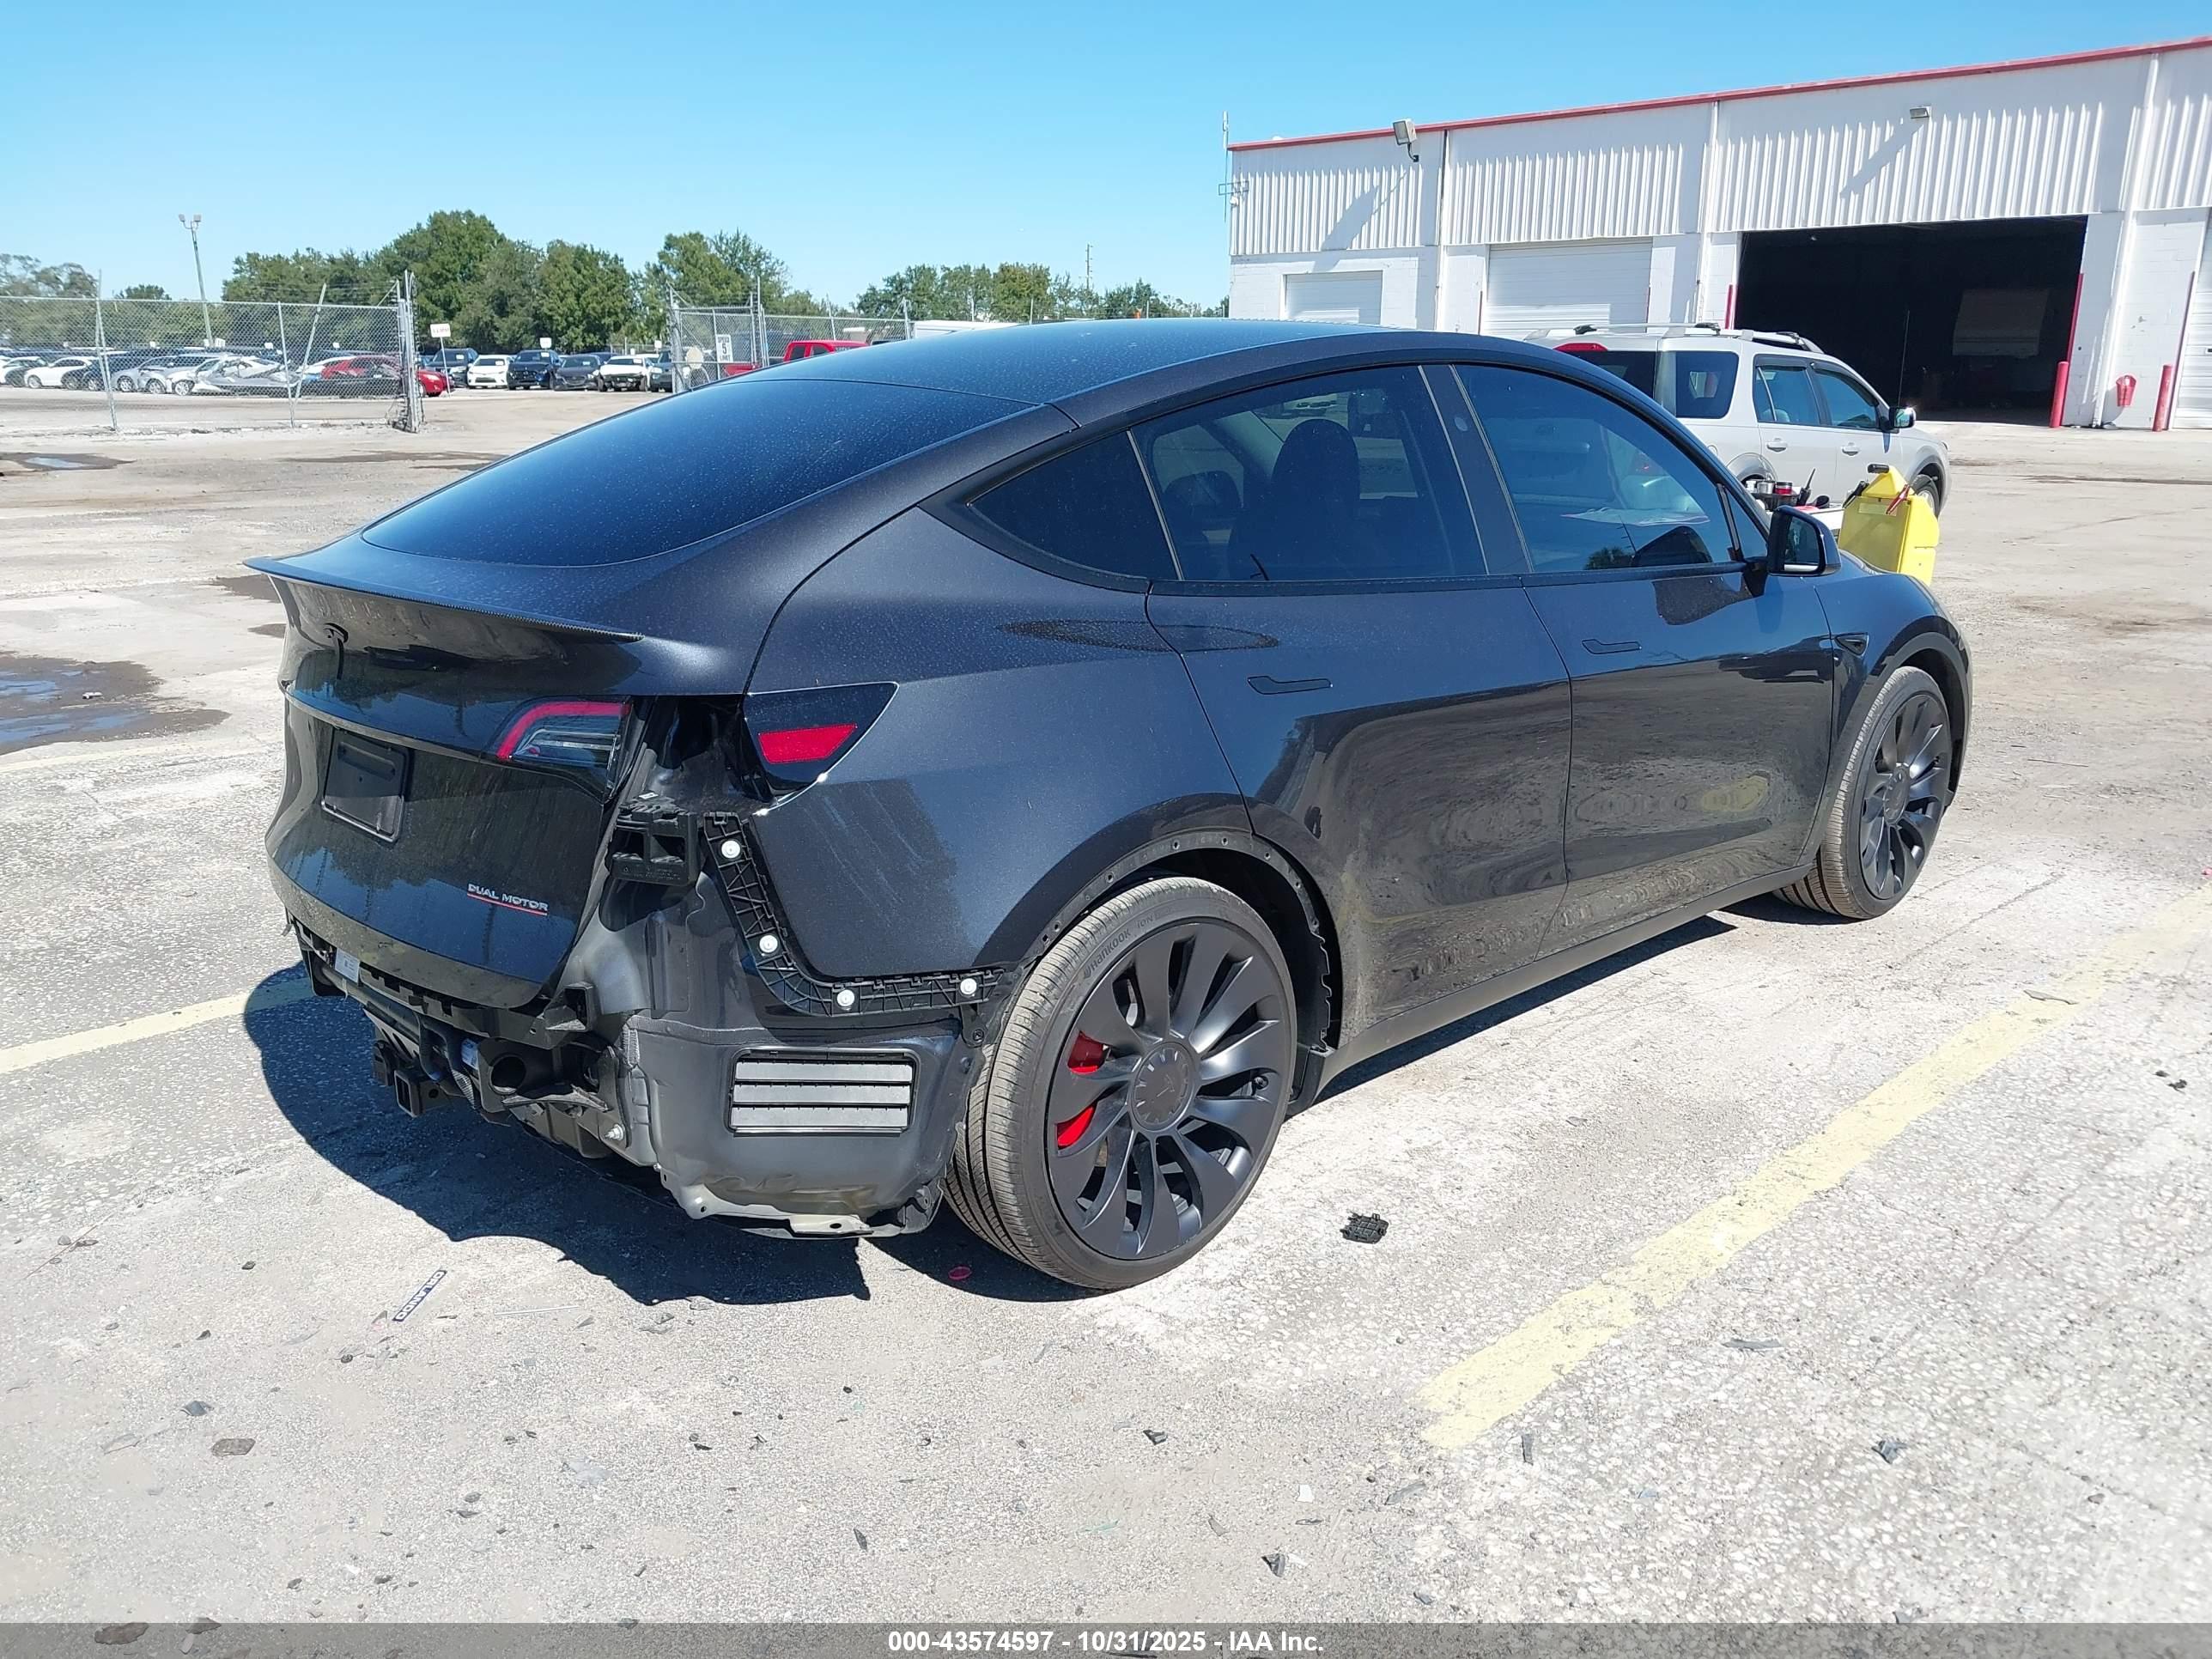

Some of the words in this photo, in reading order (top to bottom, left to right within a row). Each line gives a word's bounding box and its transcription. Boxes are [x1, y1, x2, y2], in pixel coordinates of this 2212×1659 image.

[721, 343, 727, 355] 5
[468, 883, 499, 900] DUAL
[501, 893, 550, 912] MOTOR
[394, 1271, 446, 1320] ORLANDO
